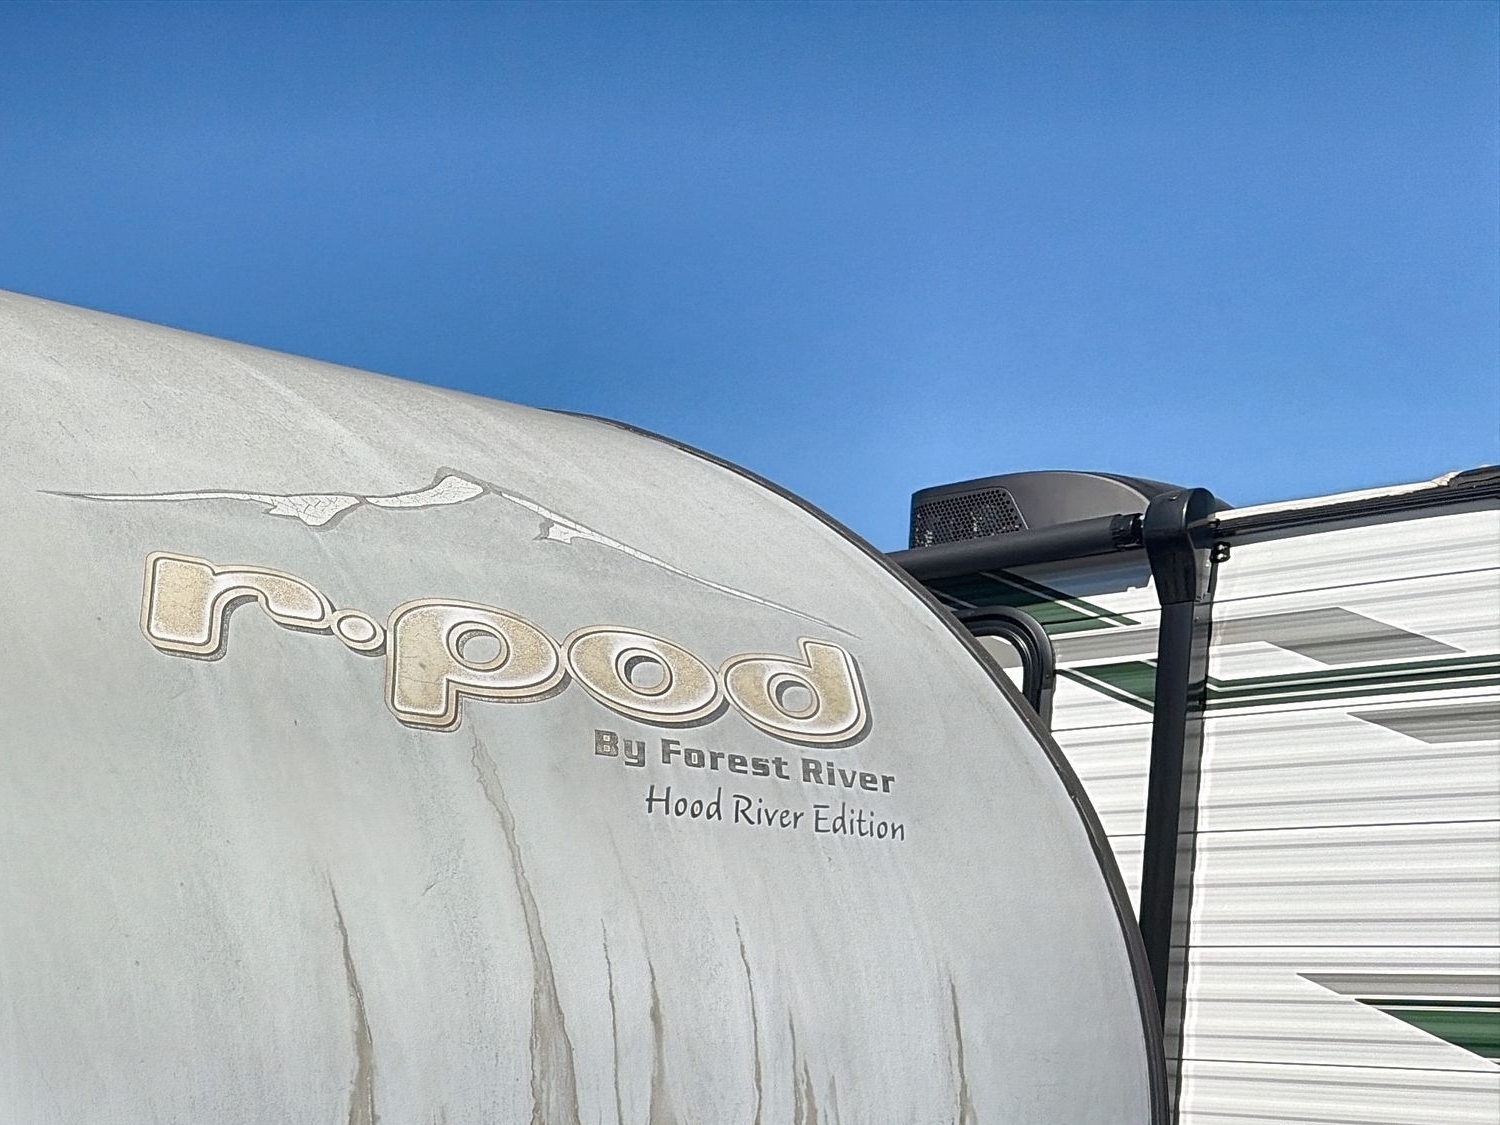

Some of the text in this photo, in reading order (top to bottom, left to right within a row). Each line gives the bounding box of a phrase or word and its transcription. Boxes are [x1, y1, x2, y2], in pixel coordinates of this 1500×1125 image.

[594, 728, 896, 793] By Forest River
[645, 784, 906, 841] Hood River Edition
